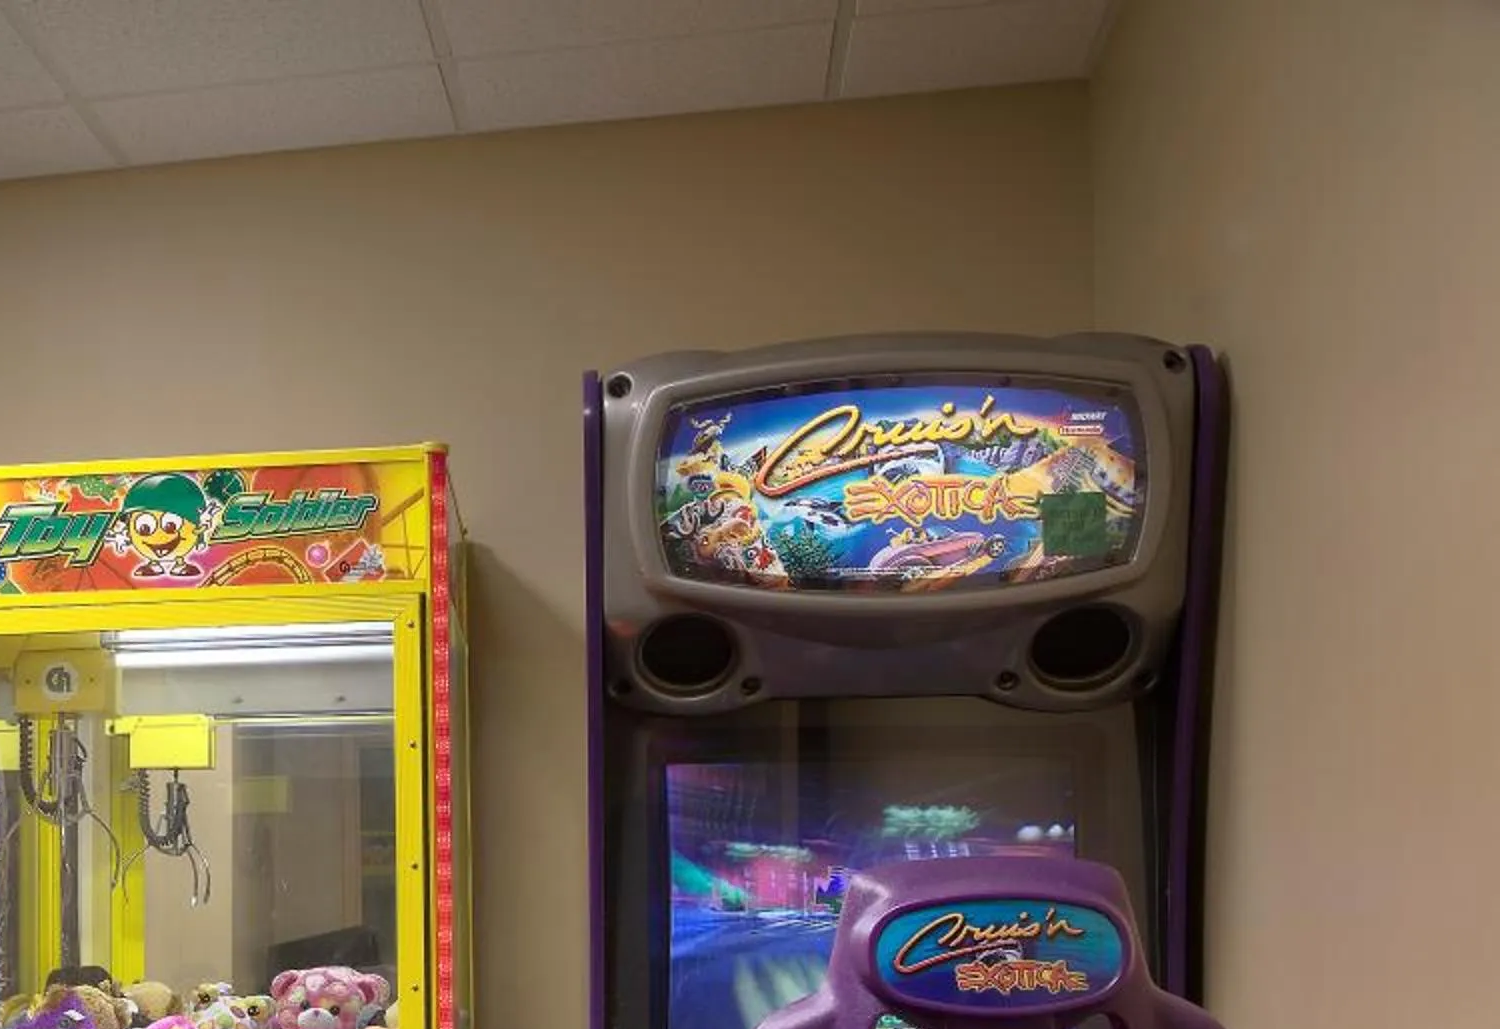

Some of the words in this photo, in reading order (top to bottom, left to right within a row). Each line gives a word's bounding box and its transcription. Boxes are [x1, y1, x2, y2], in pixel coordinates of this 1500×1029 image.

[755, 395, 1038, 497] Cruis'n
[209, 489, 380, 542] Soldier
[844, 476, 1042, 524] EXOTICA
[894, 906, 1084, 973] Cruis'n
[955, 959, 1089, 994] EXOTICA
